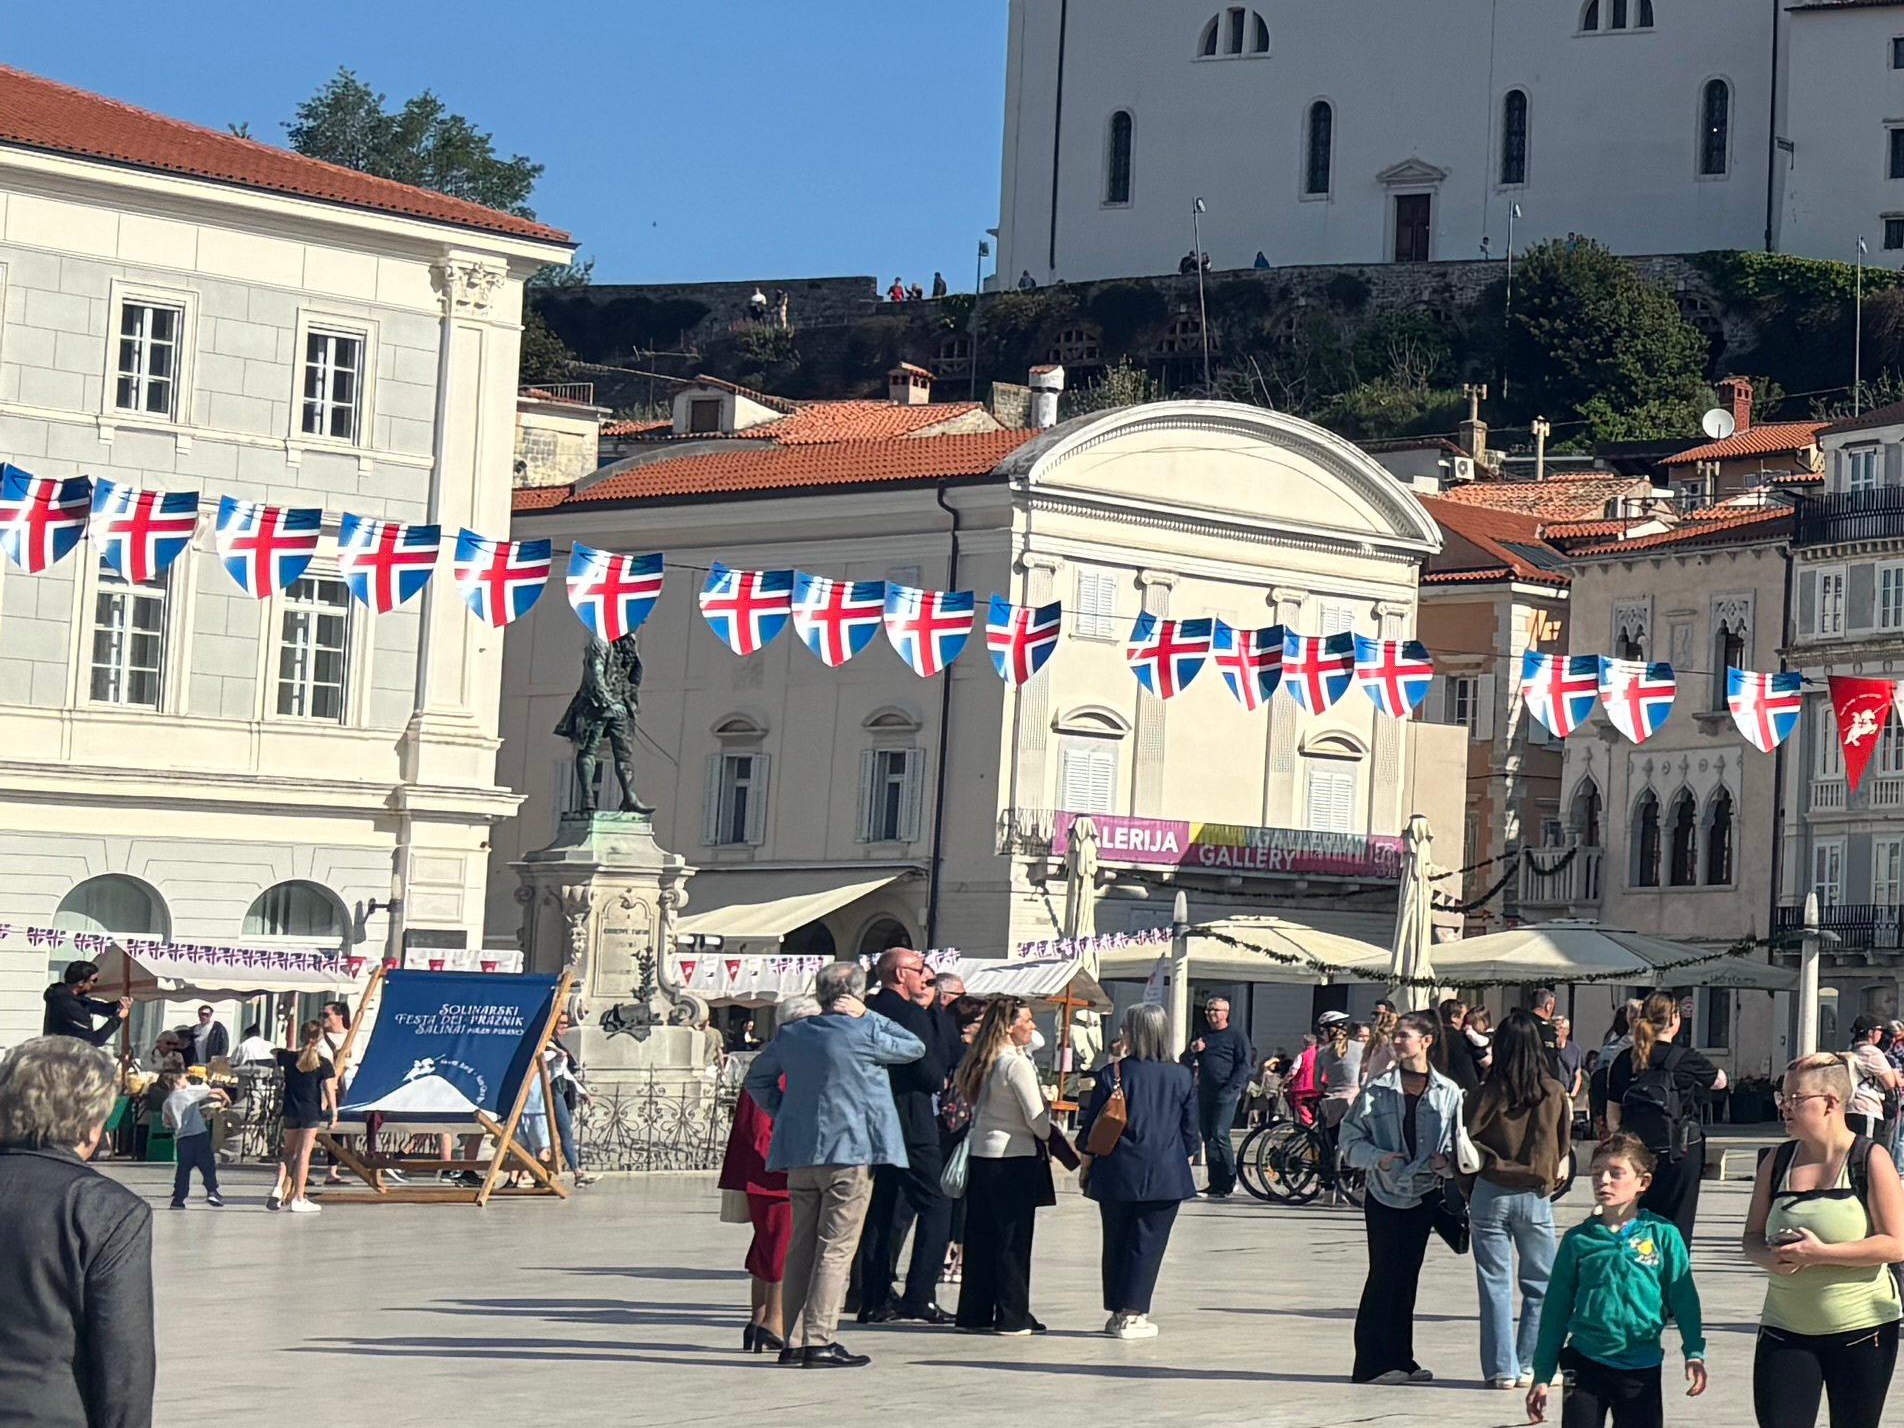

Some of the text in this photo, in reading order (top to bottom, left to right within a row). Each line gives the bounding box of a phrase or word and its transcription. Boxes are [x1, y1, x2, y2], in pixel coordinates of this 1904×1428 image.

[1095, 826, 1180, 854] LERIJA
[1199, 844, 1296, 871] GALLERY
[395, 1013, 437, 1025] FESTA
[439, 1003, 519, 1017] SOLINARSKI
